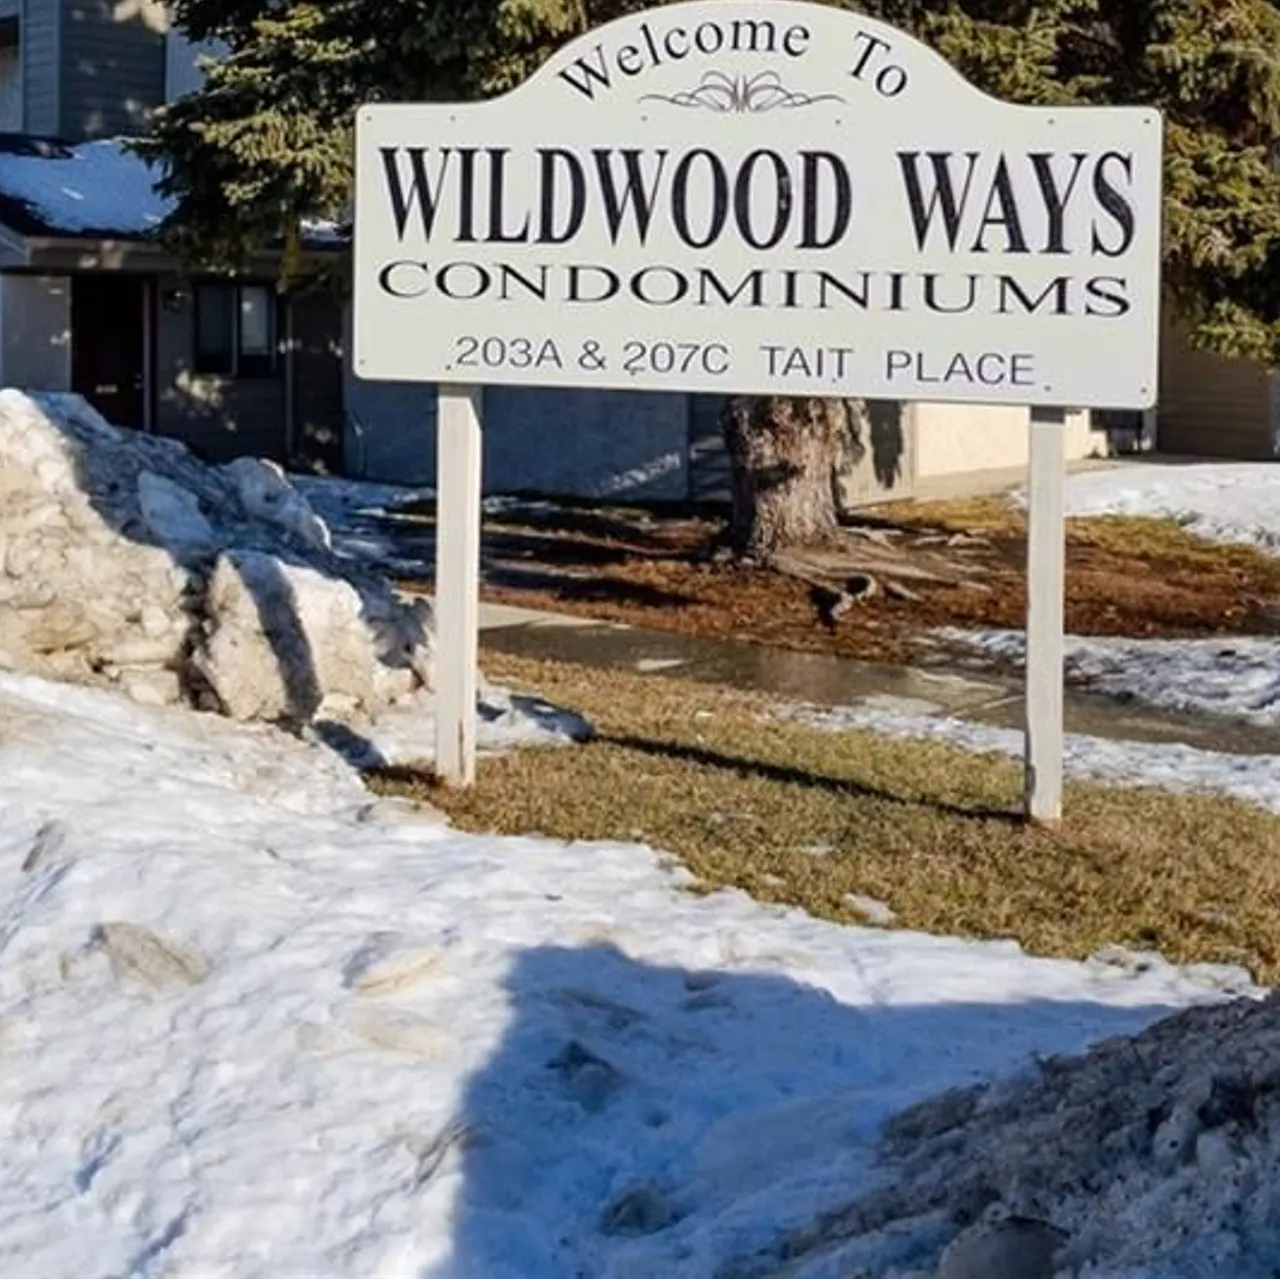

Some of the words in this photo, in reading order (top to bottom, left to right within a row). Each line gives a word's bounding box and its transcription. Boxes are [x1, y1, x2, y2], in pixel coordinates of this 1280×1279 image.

[558, 18, 811, 102] Welcome
[849, 30, 909, 98] To
[378, 146, 852, 251] WILDWOOD
[895, 150, 1136, 258] WAYS
[377, 260, 1131, 318] CONDOMINIUMS
[454, 335, 564, 371] 203A
[578, 341, 608, 372] &
[622, 340, 730, 376] 207C
[760, 346, 854, 379] TAIT
[885, 351, 1036, 386] PLACE
